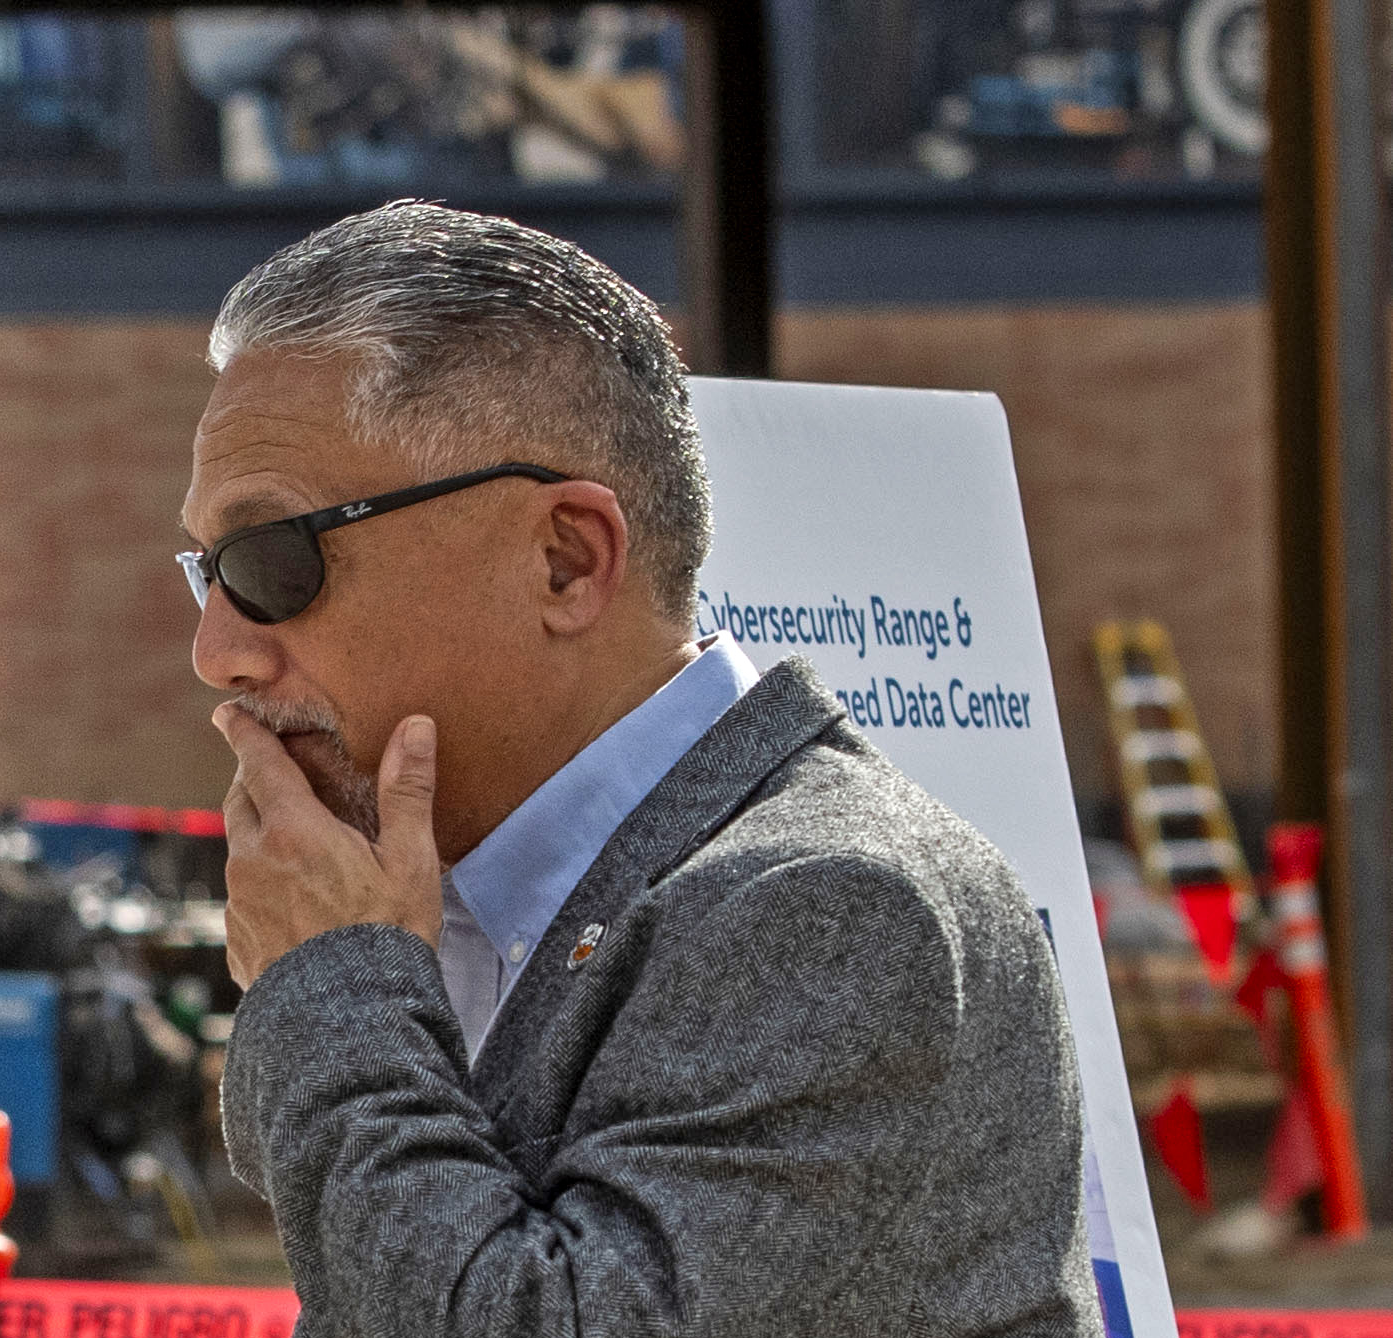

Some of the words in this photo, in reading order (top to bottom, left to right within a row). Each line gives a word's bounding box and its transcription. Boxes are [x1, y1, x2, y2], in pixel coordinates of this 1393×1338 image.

[870, 595, 950, 660] Range
[953, 597, 973, 648] &
[884, 677, 945, 729] Data
[948, 678, 1031, 729] Center
